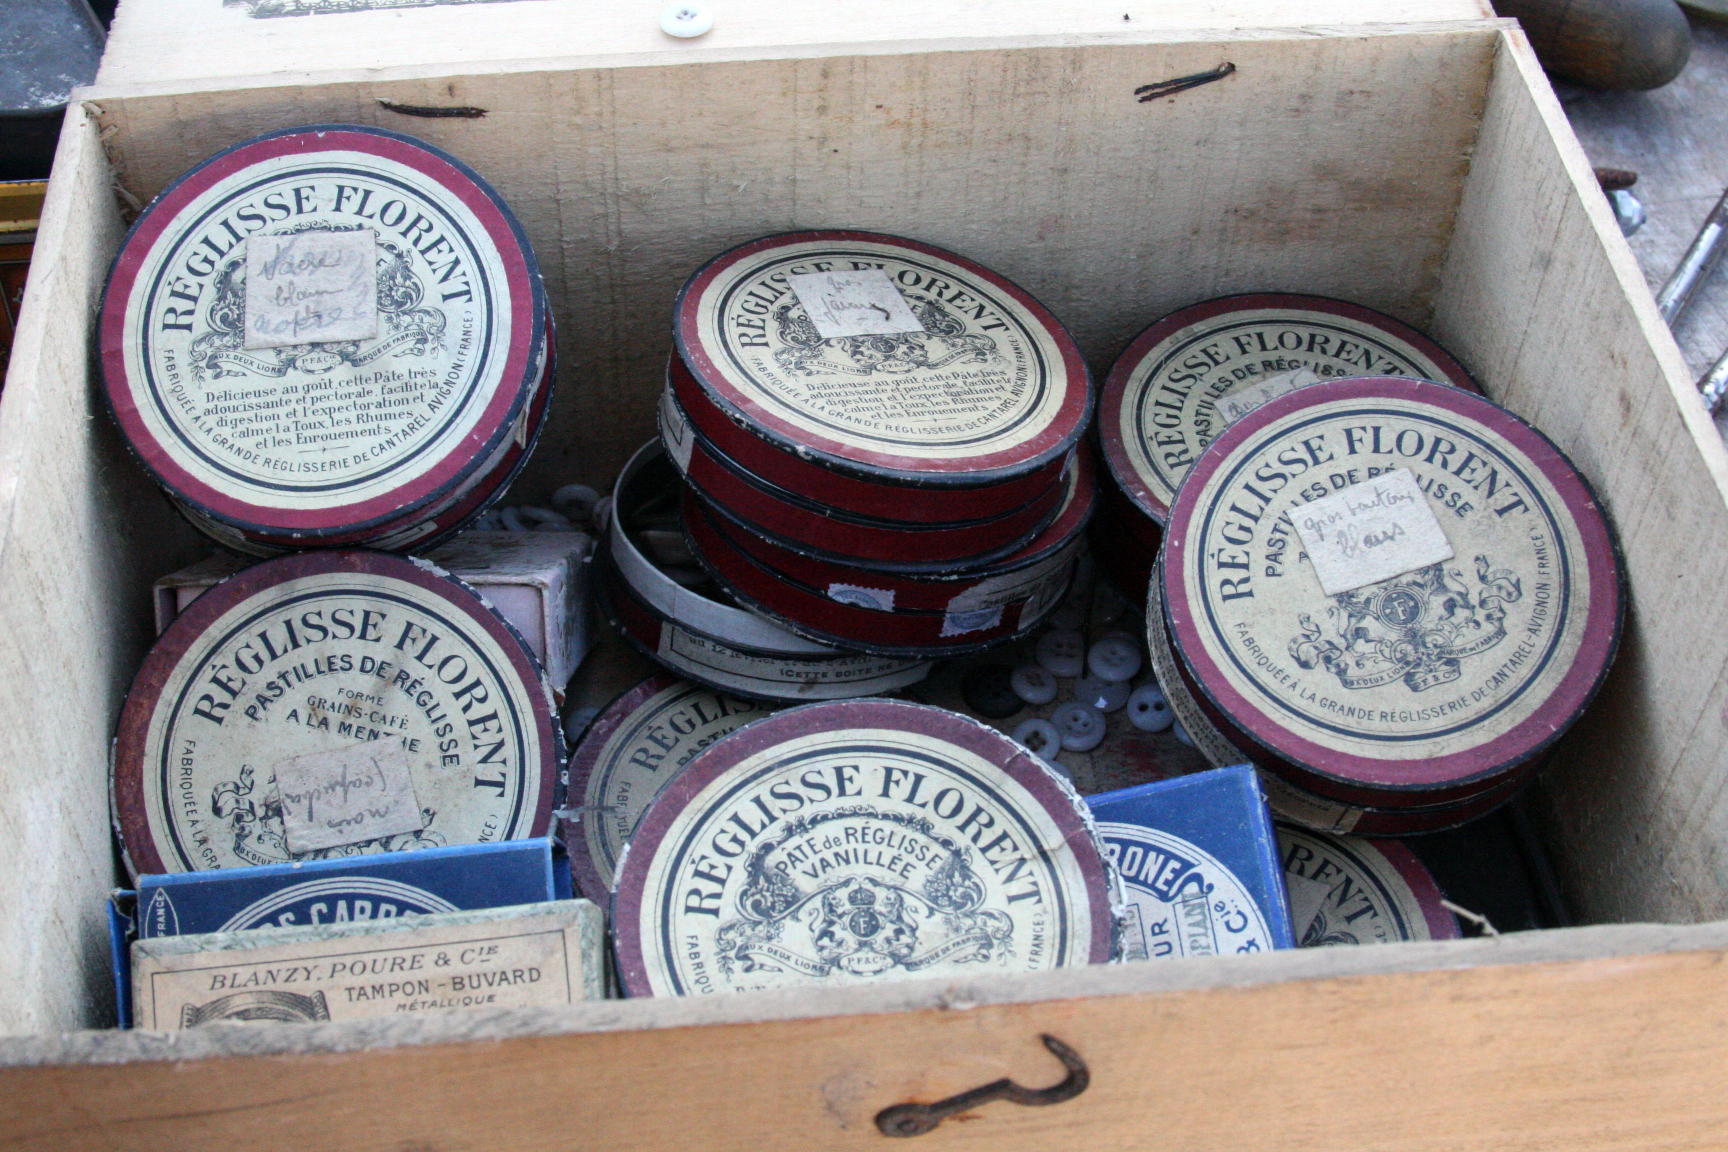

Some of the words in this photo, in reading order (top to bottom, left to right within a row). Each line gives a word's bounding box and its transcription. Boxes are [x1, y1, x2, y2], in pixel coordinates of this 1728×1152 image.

[162, 185, 318, 333] RÉGLISSE
[331, 184, 473, 304] FLORENT
[233, 354, 256, 368] DEUX
[1230, 362, 1260, 381] DE
[205, 387, 277, 403] Délicieuse
[282, 385, 299, 395] au
[338, 374, 371, 388] cette
[373, 369, 404, 383] Pâte
[408, 367, 437, 379] très
[750, 356, 802, 399] FABRIQUÉE
[811, 400, 826, 412] LA
[827, 409, 881, 430] GRANDE
[885, 423, 966, 436] RÉGLISSERIE
[965, 420, 980, 430] DE
[976, 396, 1019, 425] CANTAREL
[805, 380, 870, 392] Délicieuse
[951, 369, 979, 381] Pâte
[810, 386, 888, 401] adoucissante
[890, 384, 901, 394] et
[825, 394, 882, 408] digestion
[887, 391, 899, 402] et
[993, 383, 1006, 393] et
[164, 349, 197, 415] FABRIQUÉE
[198, 421, 214, 437] LA
[212, 432, 261, 465] GRANDE
[262, 457, 350, 473] RÉGLISSERIE
[354, 452, 371, 465] DE
[370, 411, 432, 457] CANTAREL
[427, 361, 465, 415] AVIGNON
[203, 396, 292, 417] adoucissante
[295, 395, 307, 405] et
[216, 410, 281, 429] digestion
[286, 407, 299, 418] et
[303, 394, 410, 419] l'expectoration
[412, 392, 426, 404] et
[843, 403, 880, 414] calme
[931, 398, 950, 408] les
[951, 393, 1002, 406] Rhumes
[884, 409, 904, 420] les
[905, 403, 989, 419] Enrouements
[1148, 342, 1231, 470] RÉGLISSE
[1231, 330, 1406, 376] FLORENT
[231, 423, 273, 438] calme
[330, 416, 352, 428] les
[356, 408, 414, 425] Rhumes
[256, 438, 269, 450] et
[273, 435, 293, 448] les
[296, 423, 392, 445] Enrouements
[1208, 433, 1334, 604] RÉGLISSE
[1341, 425, 1531, 519] FLORENT
[1264, 481, 1329, 578] PASTIES
[1328, 468, 1361, 490] DE
[1233, 622, 1291, 685] FABRIQUÉE
[1300, 687, 1316, 704] LA
[1319, 697, 1375, 721] GRANDE
[1379, 696, 1471, 723] RÉGLISSERIE
[1471, 687, 1489, 702] DE
[1362, 675, 1385, 686] DEUX
[192, 608, 387, 727] RÉGLISSE
[394, 619, 507, 798] FLORENT
[244, 653, 354, 722] PASTILLES
[359, 655, 393, 680] DE
[392, 669, 461, 768] RÉGLISSE
[306, 695, 409, 730] GRAINS-CAFÉ
[337, 687, 385, 706] FORME
[306, 713, 330, 731] LA
[179, 739, 199, 817] FABRIQUÉE
[201, 847, 222, 870] GRA
[684, 764, 863, 919] RÉGLISSE
[876, 765, 1043, 906] FLORENT
[774, 836, 823, 878] PÂTE
[822, 834, 843, 850] de
[844, 820, 943, 871] RÉGLISSE
[801, 847, 917, 881] VANILLÉE
[157, 893, 166, 937] FRANCE
[329, 953, 425, 979] POURE
[434, 951, 451, 967] &
[686, 934, 715, 995] FABRIQU
[1026, 912, 1046, 971] (FRANCE)
[767, 946, 791, 962] DEUX
[345, 979, 430, 1002] TAMPON
[452, 967, 542, 991] BUVARD
[396, 993, 497, 1013] MÉTALLIQUE
